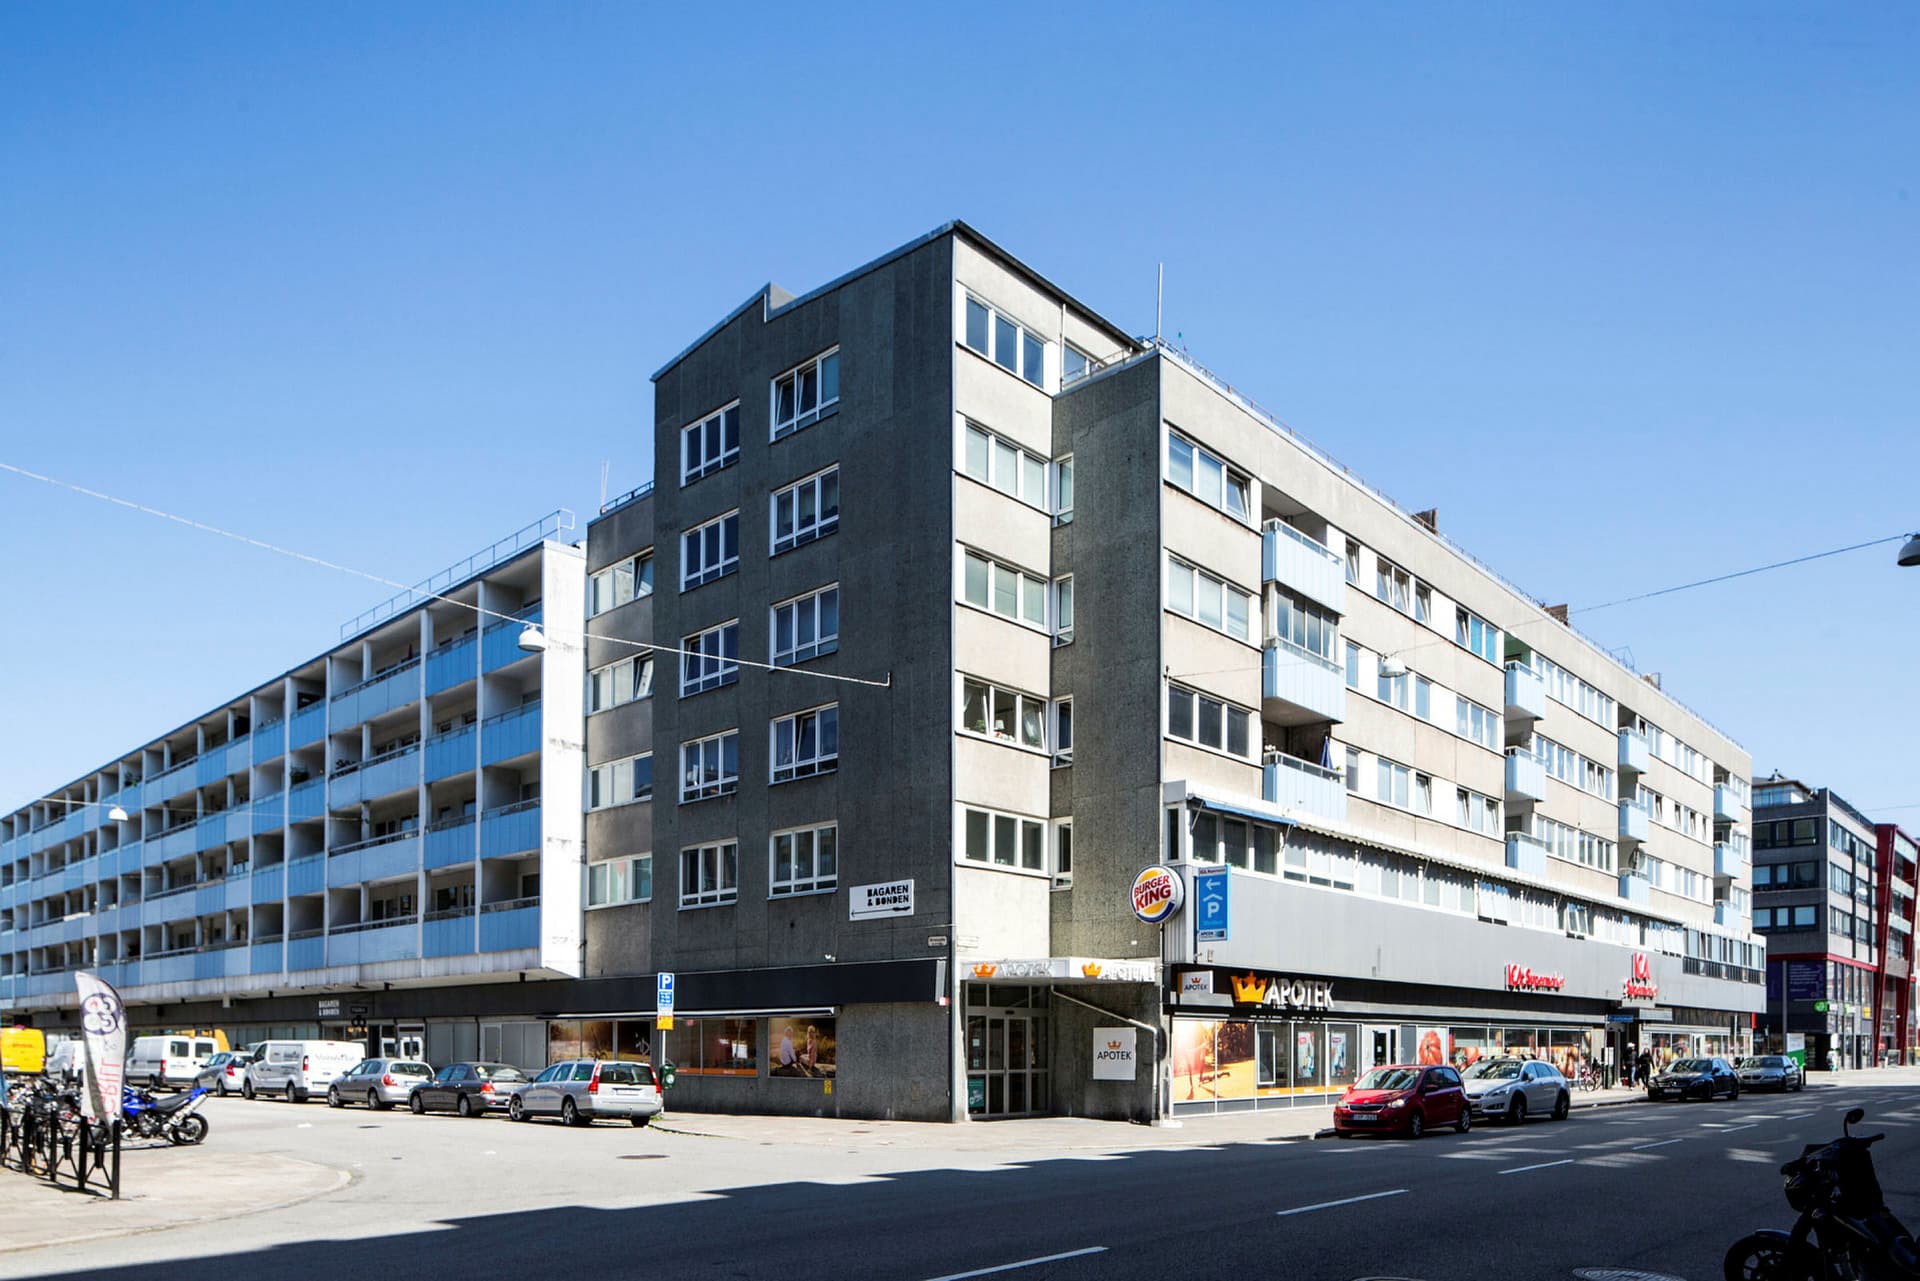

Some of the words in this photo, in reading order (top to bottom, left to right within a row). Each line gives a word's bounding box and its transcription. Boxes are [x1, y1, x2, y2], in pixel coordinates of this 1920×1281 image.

[867, 884, 909, 897] BAGAREN
[1134, 875, 1170, 898] BURGER
[867, 899, 873, 907] &
[875, 895, 909, 906] BONDEN
[1135, 885, 1172, 912] KING
[1207, 902, 1220, 918] P
[662, 975, 672, 989] P
[1184, 982, 1208, 991] APOTEK
[1264, 977, 1335, 1008] APOTEK
[1096, 1050, 1132, 1060] APOTEK
